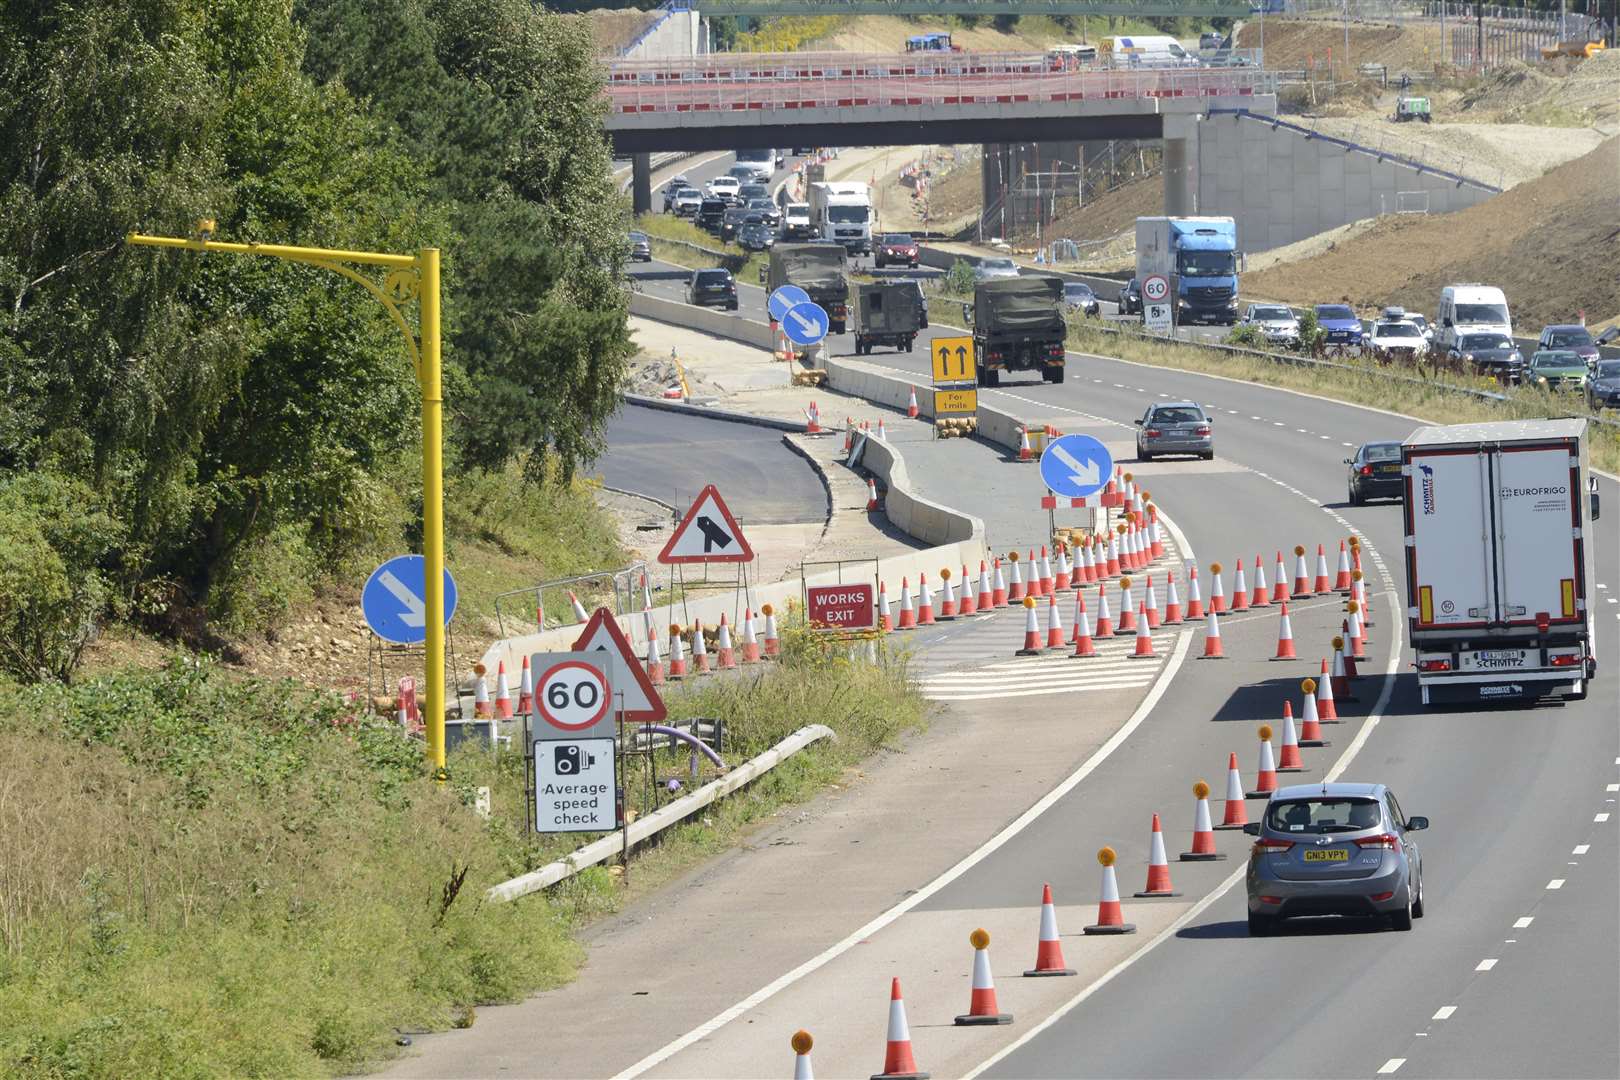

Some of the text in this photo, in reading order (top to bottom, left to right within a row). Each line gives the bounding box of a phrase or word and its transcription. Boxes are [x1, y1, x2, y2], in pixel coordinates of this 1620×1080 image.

[1148, 283, 1165, 294] 60
[1513, 486, 1566, 496] EUROFRIGO
[816, 592, 865, 606] WORKS
[826, 610, 854, 622] EXIT
[1476, 659, 1524, 668] SCHMITZ
[548, 681, 598, 710] 60
[544, 783, 607, 796] Average
[554, 798, 598, 811] speed
[554, 812, 598, 824] check
[1306, 850, 1346, 860] GN13 VPY
